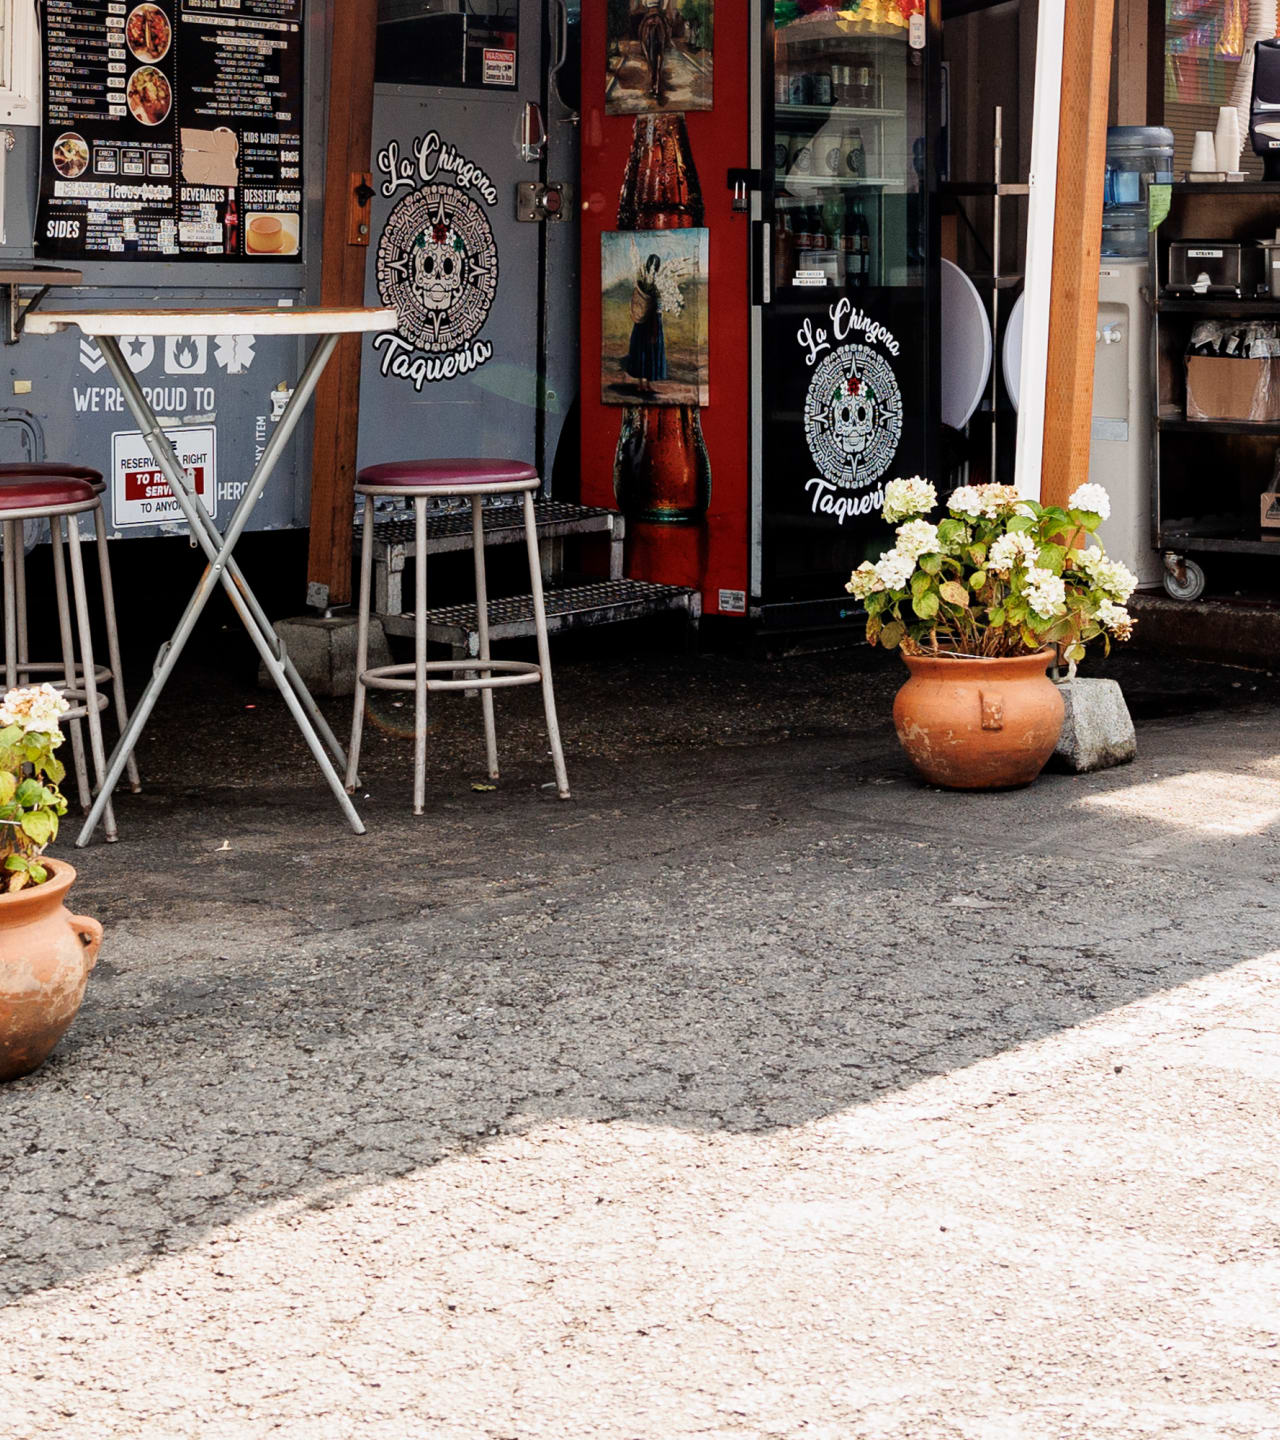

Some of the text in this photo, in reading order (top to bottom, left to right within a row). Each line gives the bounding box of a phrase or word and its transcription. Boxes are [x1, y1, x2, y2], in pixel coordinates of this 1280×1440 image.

[243, 132, 279, 144] KIDS MENU
[377, 131, 498, 205] La Chingona
[180, 188, 277, 203] BEVERAGES DESSERT
[46, 220, 80, 239] SIDES
[797, 297, 901, 366] La Chingona
[73, 386, 215, 412] WE'RE ROUD TO
[255, 415, 267, 442] ITEM
[182, 453, 208, 465] RIGHT
[136, 474, 150, 484] TO
[141, 502, 152, 513] TO
